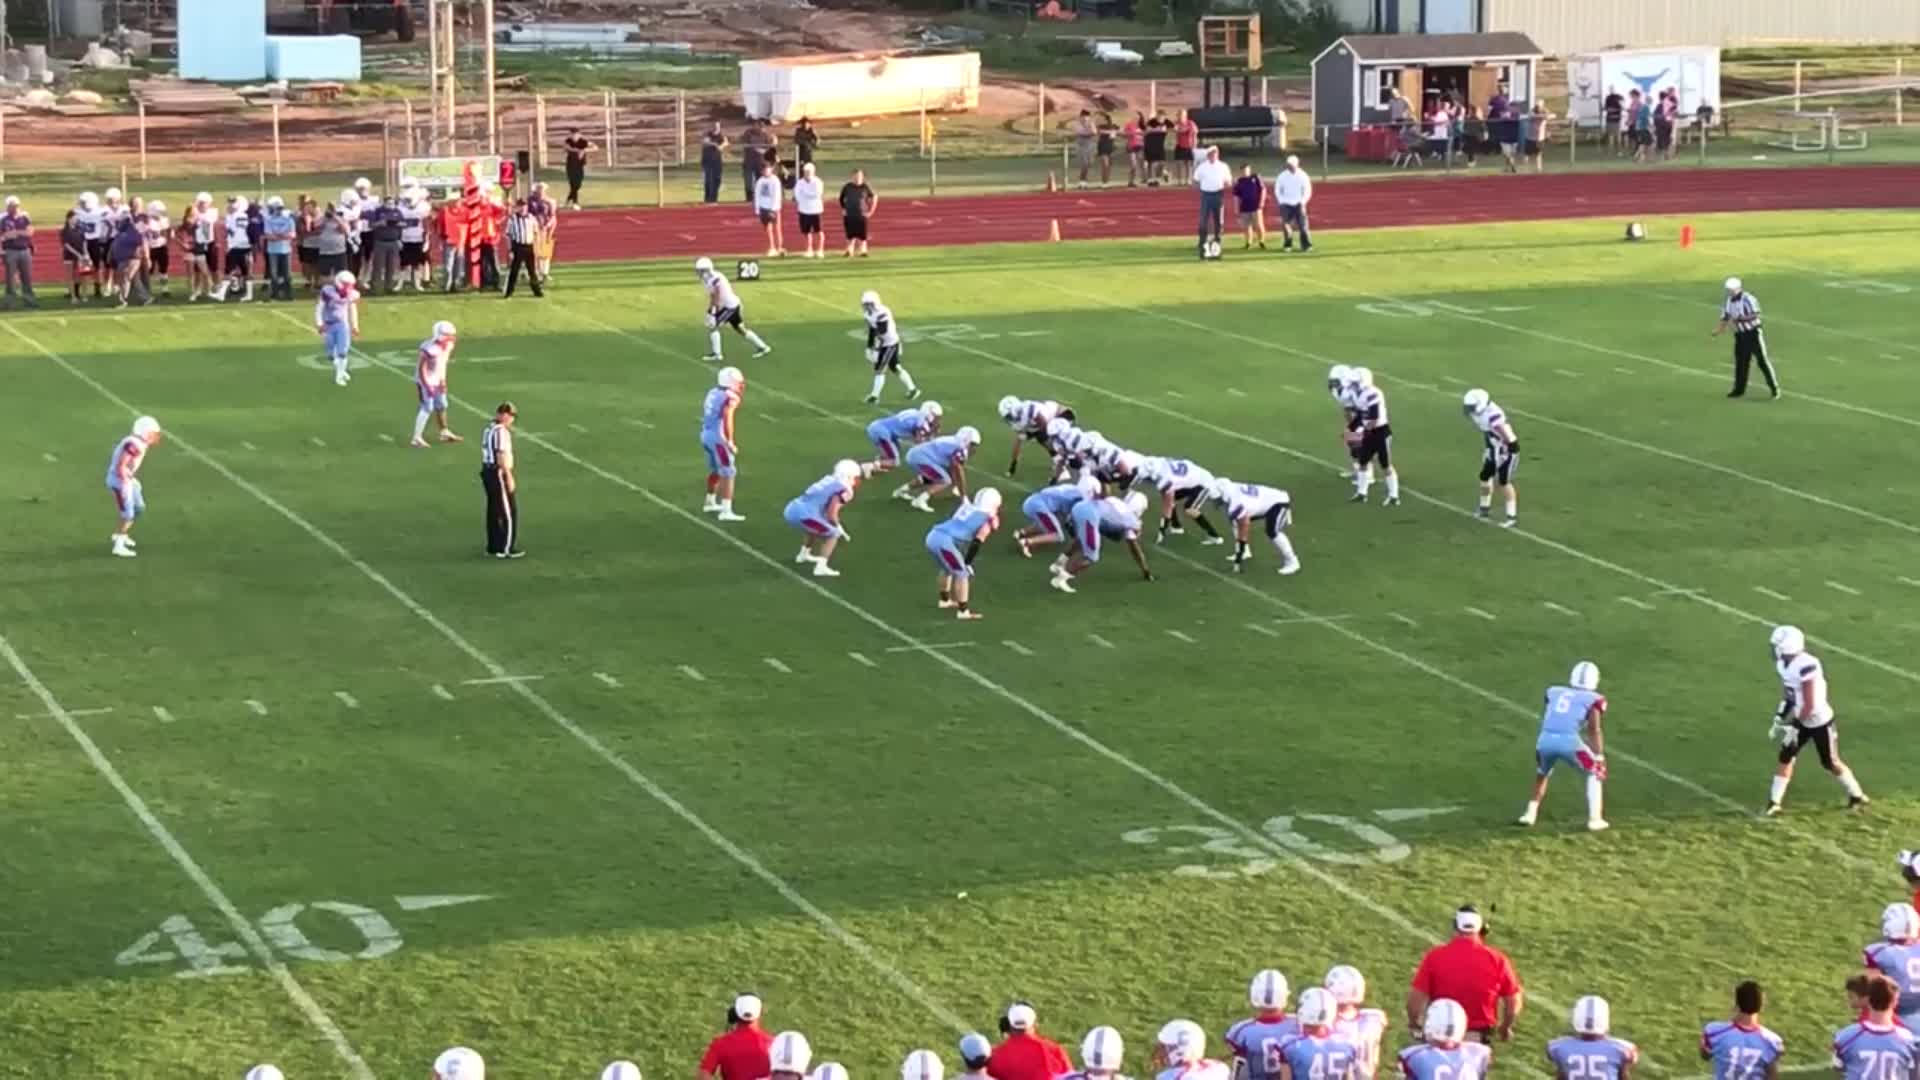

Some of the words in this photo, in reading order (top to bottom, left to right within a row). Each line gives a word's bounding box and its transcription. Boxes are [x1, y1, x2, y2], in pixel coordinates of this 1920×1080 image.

[1203, 241, 1221, 257] 10
[740, 261, 759, 278] 20
[1556, 691, 1575, 713] 6
[1120, 813, 1412, 877] 30
[115, 901, 404, 979] 40
[1308, 1051, 1346, 1080] 45
[1567, 1054, 1608, 1080] 25
[1724, 1047, 1763, 1080] 17
[1858, 1050, 1901, 1080] 70
